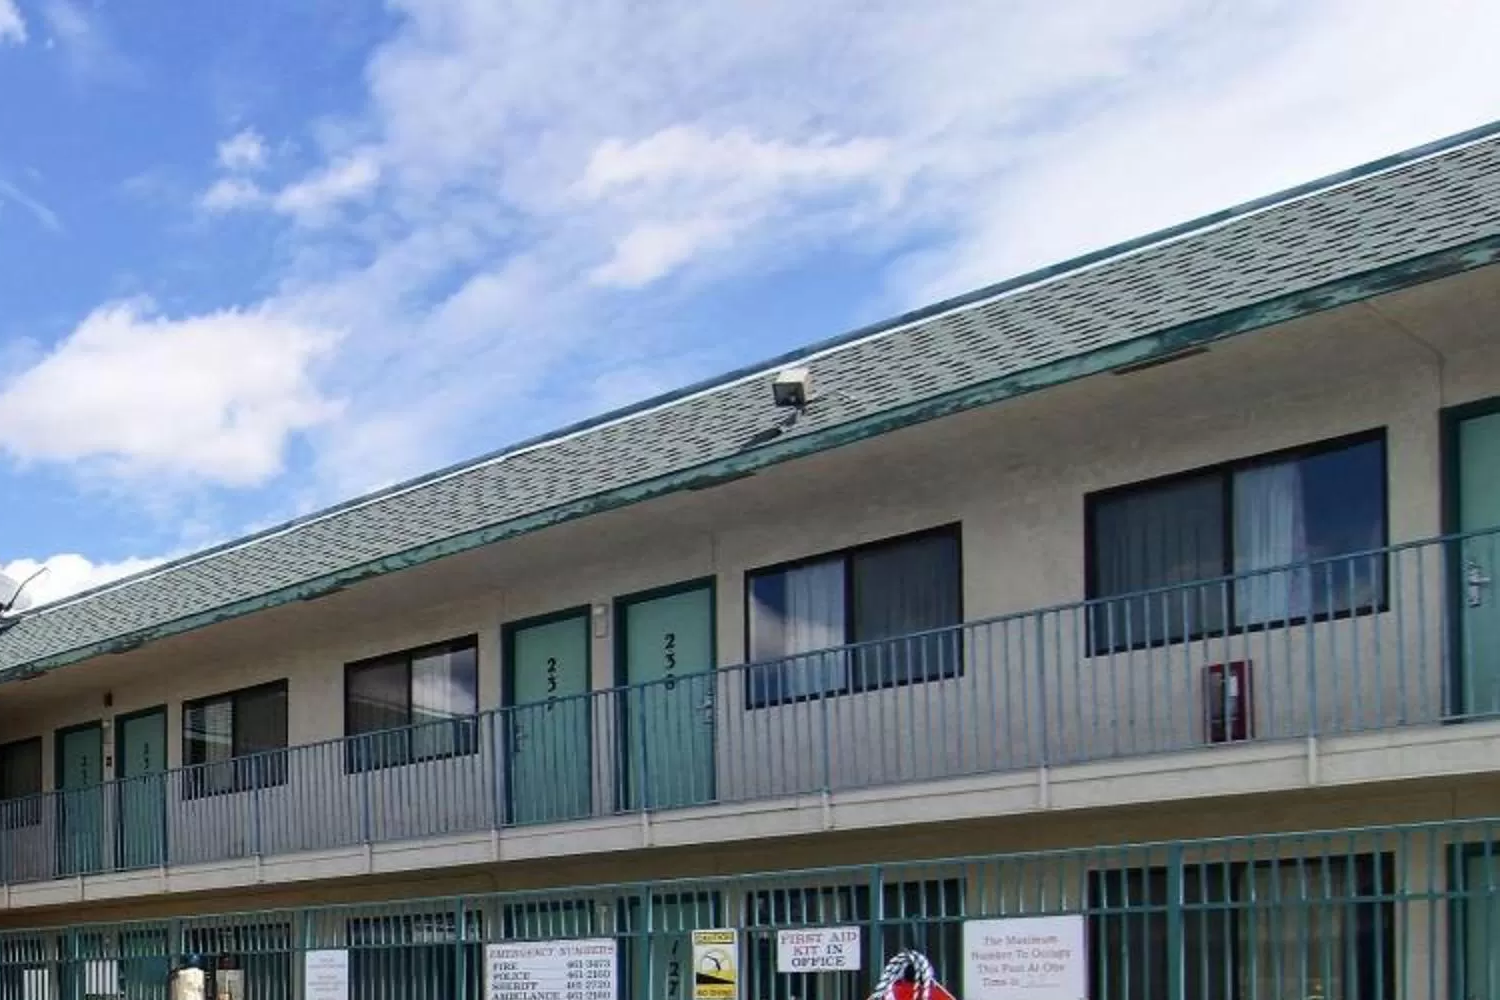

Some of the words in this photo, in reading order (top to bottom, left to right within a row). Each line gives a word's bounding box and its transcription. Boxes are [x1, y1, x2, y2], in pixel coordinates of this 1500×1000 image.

[781, 933, 822, 945] FIRST
[829, 931, 857, 942] AID
[794, 945, 820, 956] KIT
[826, 944, 843, 955] IN
[493, 962, 519, 971] FIRE
[791, 956, 846, 967] OFFICE
[493, 971, 531, 980] POLICE
